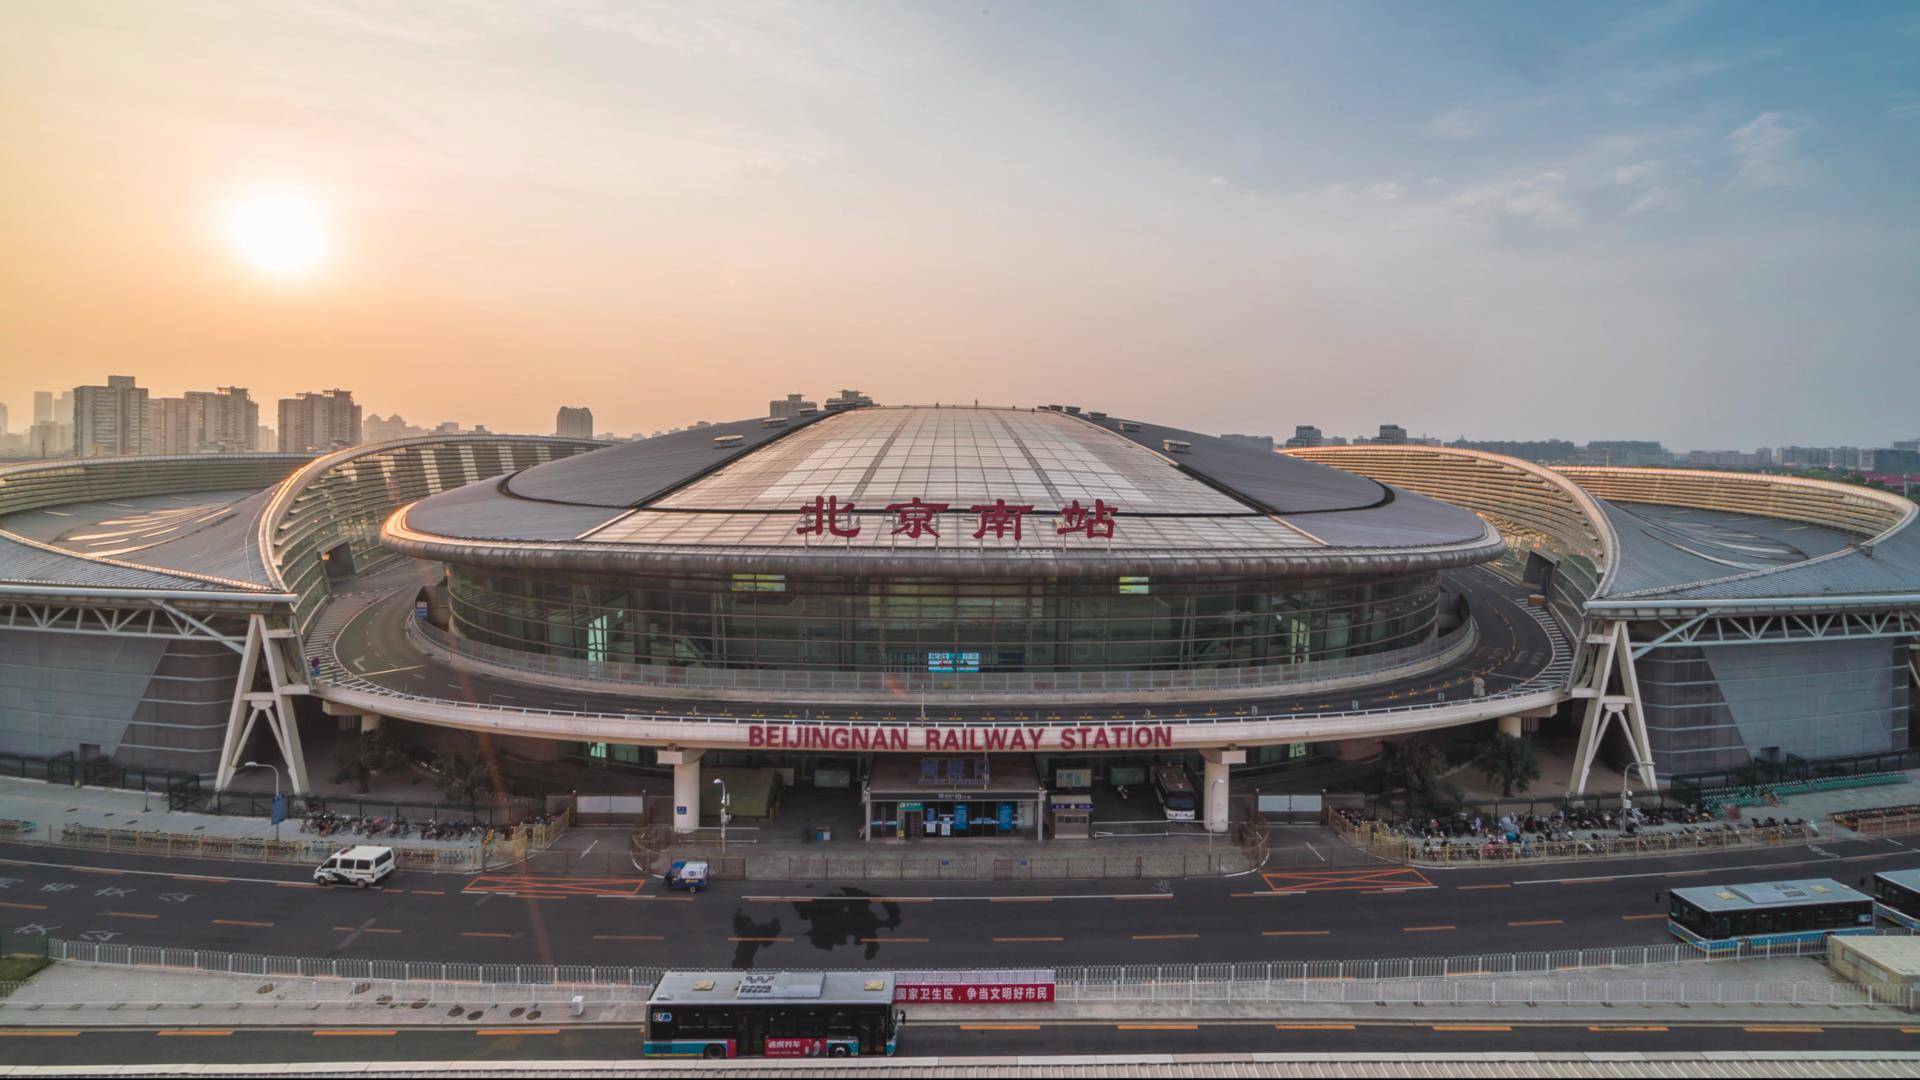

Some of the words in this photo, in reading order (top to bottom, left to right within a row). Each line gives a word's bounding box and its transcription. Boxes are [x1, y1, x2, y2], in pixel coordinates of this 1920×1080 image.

[797, 495, 1118, 540] 北京南站
[749, 726, 909, 750] BEIJINGNAN
[926, 728, 1041, 751] RAILWAY
[1062, 726, 1172, 751] STATION
